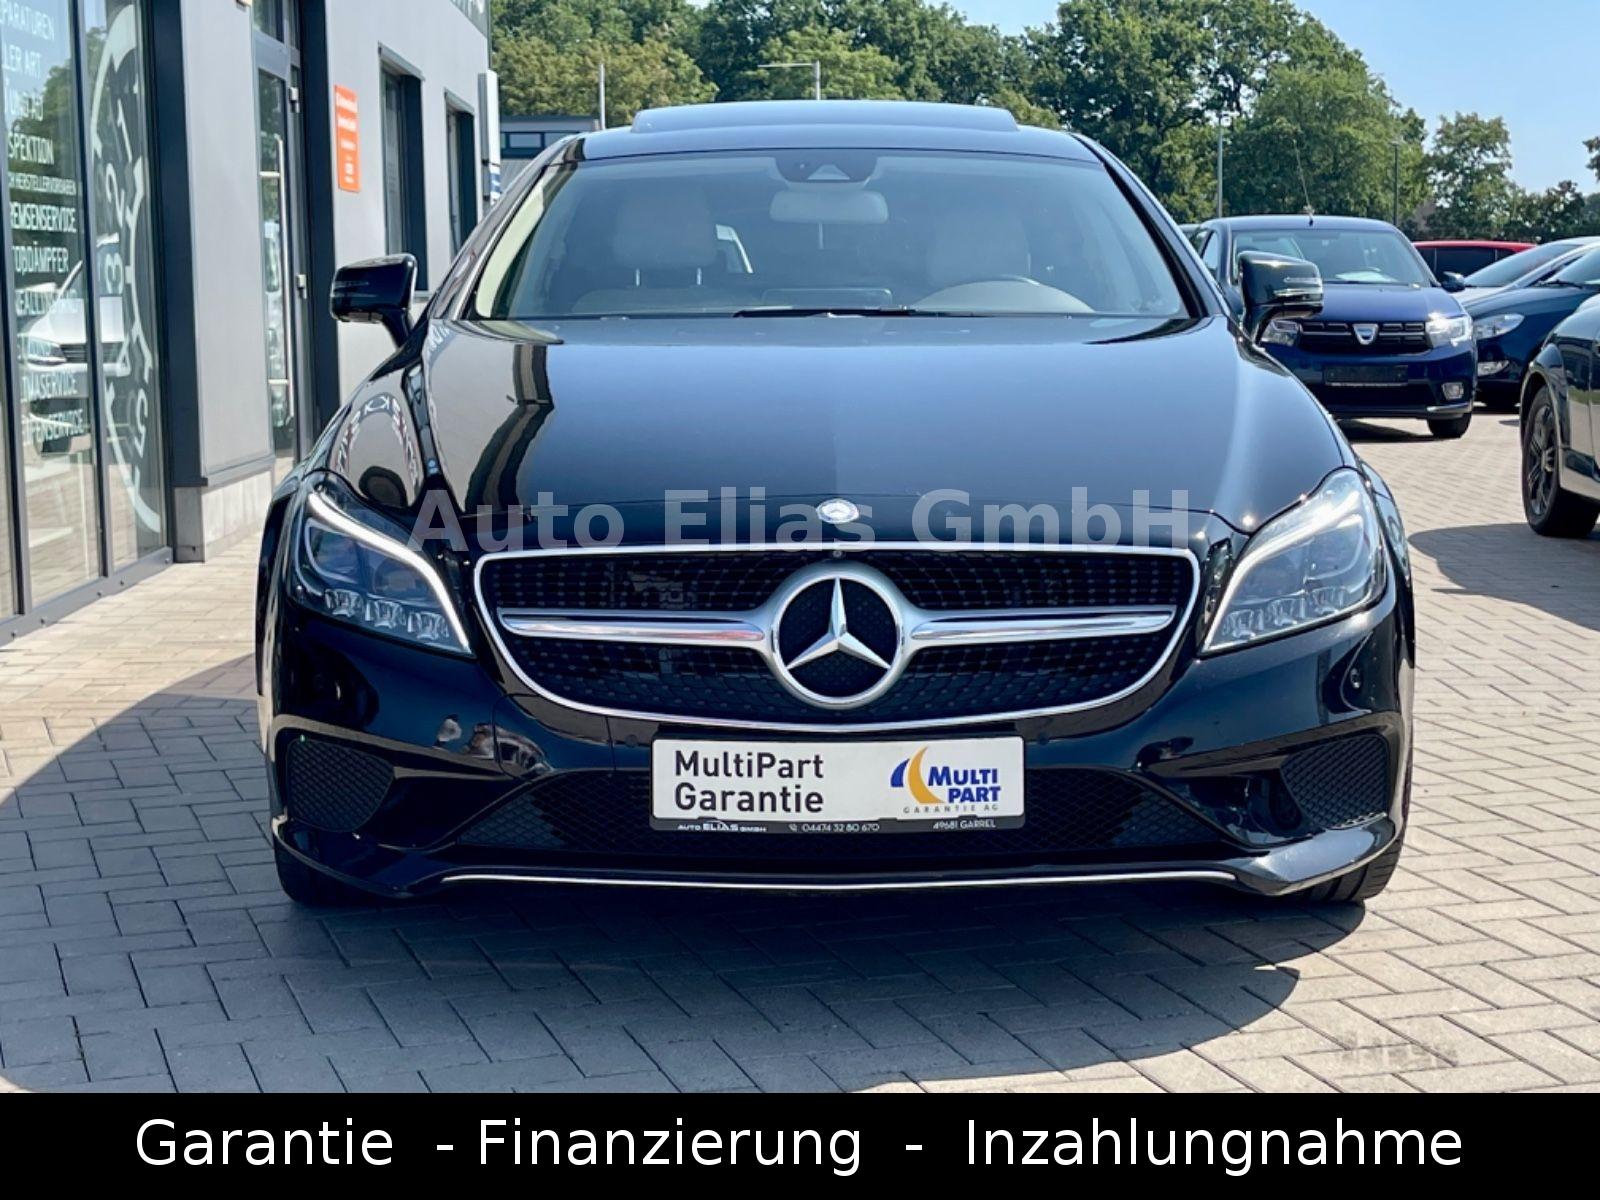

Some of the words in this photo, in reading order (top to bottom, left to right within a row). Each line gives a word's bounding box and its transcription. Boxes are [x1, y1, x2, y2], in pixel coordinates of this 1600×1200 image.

[674, 750, 824, 778] MultiPart
[674, 782, 824, 813] Garantie
[948, 786, 1001, 803] PART
[903, 804, 976, 813] GARANTIE
[984, 803, 999, 812] AG
[702, 822, 739, 832] ELIAS
[959, 819, 997, 829] GARREL
